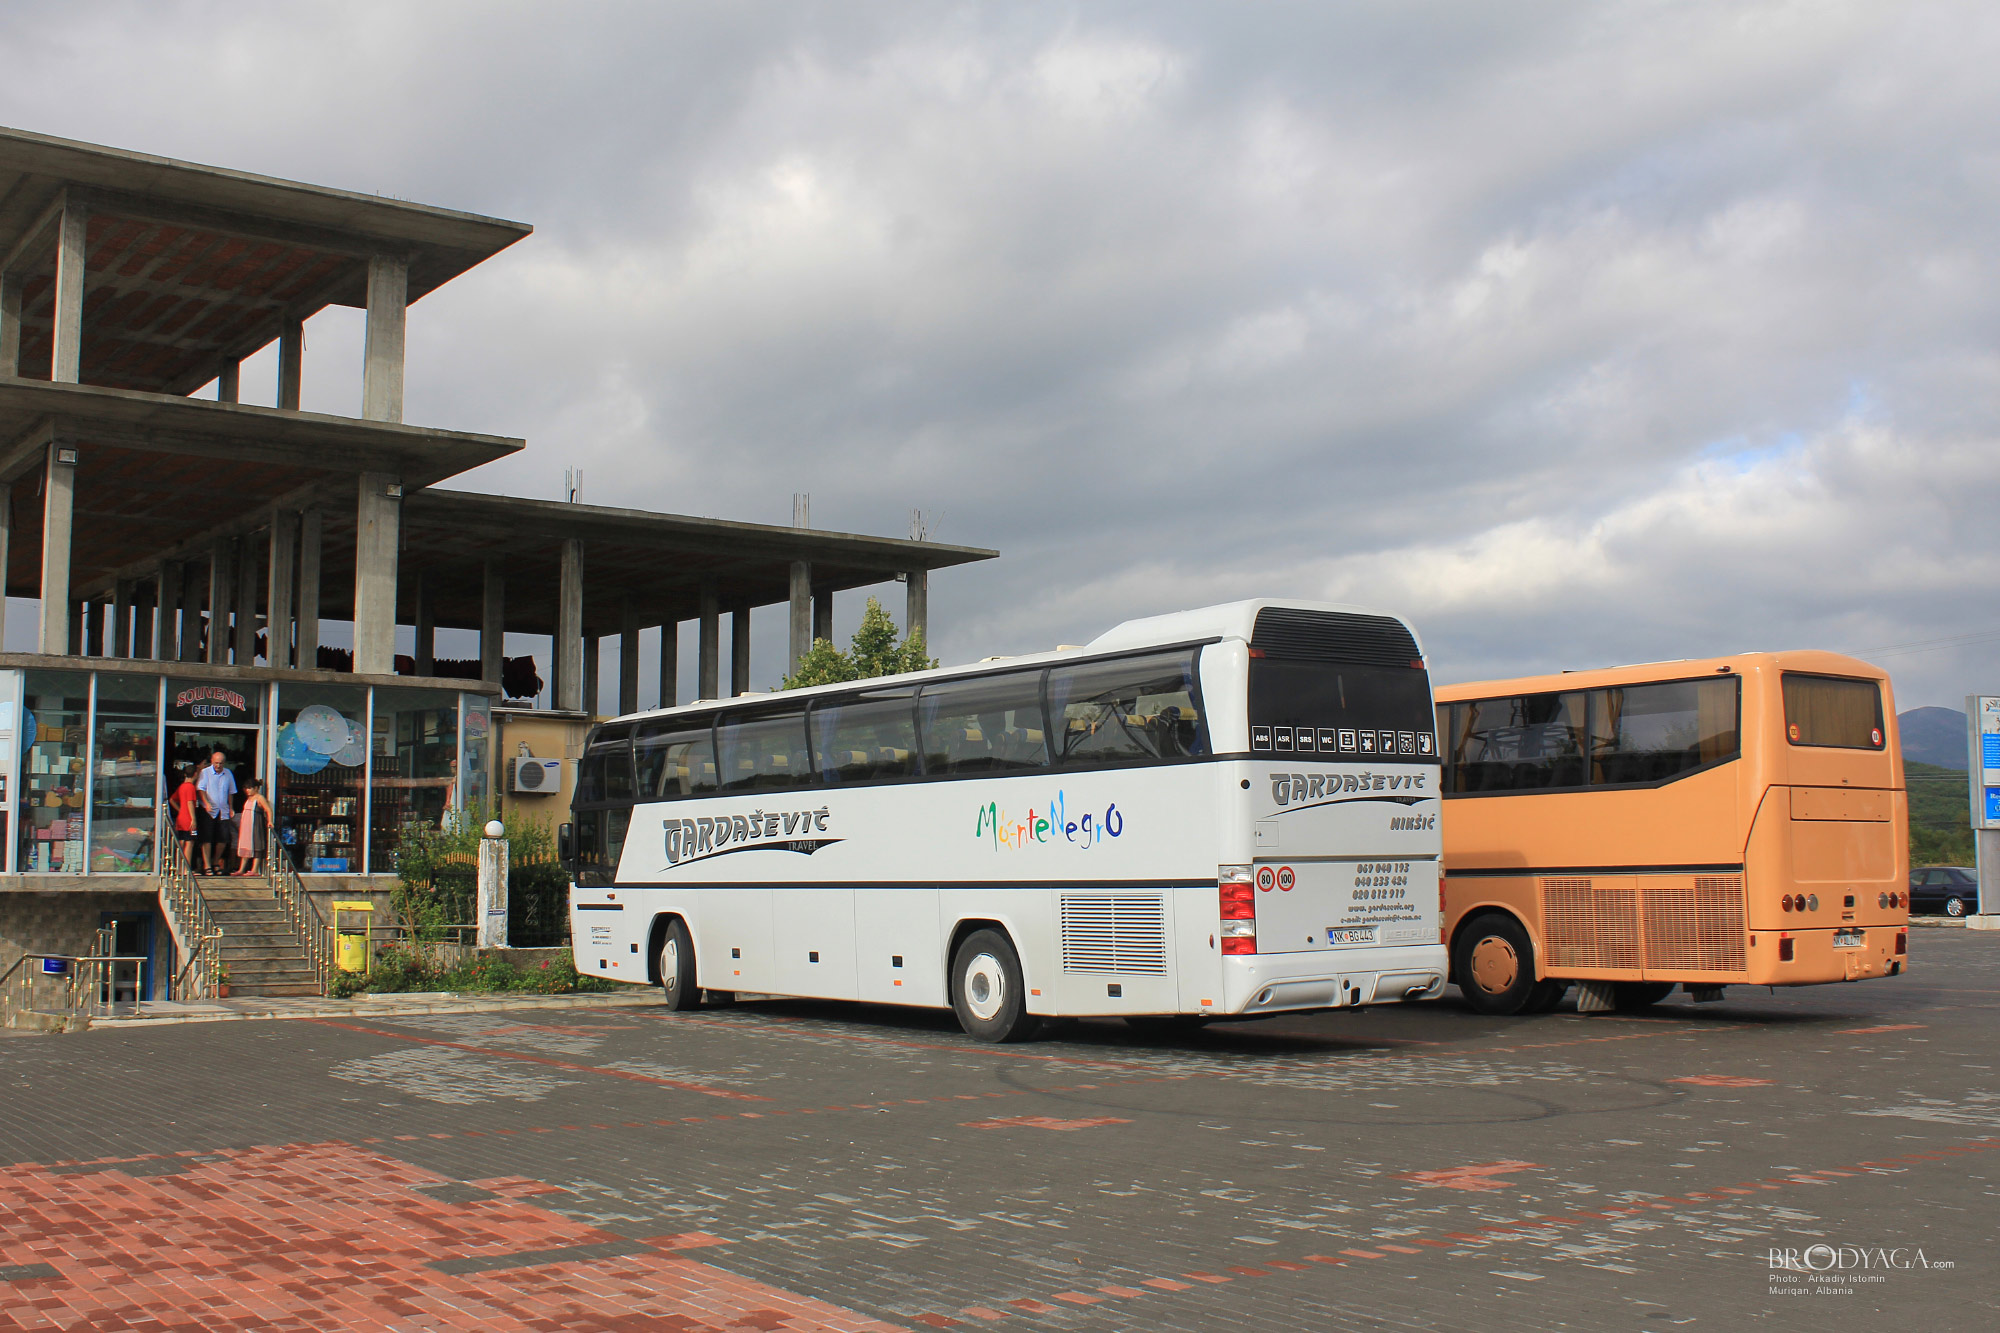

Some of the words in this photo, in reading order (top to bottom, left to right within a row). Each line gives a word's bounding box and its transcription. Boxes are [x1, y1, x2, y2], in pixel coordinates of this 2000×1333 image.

[176, 686, 246, 711] SOUVENIR
[192, 704, 230, 717] ÇELIKU
[1277, 735, 1290, 743] ASR
[1321, 736, 1333, 744] WC
[1269, 771, 1426, 805] GARDAŠEVIĆ
[1390, 813, 1436, 830] NIKŠIĆ
[662, 805, 830, 864] GARDAŠEVIĆ
[787, 840, 819, 851] TRAVEL
[1394, 862, 1410, 873] 193
[1261, 874, 1271, 884] 80
[1281, 873, 1292, 884] 100
[1333, 931, 1345, 943] NK
